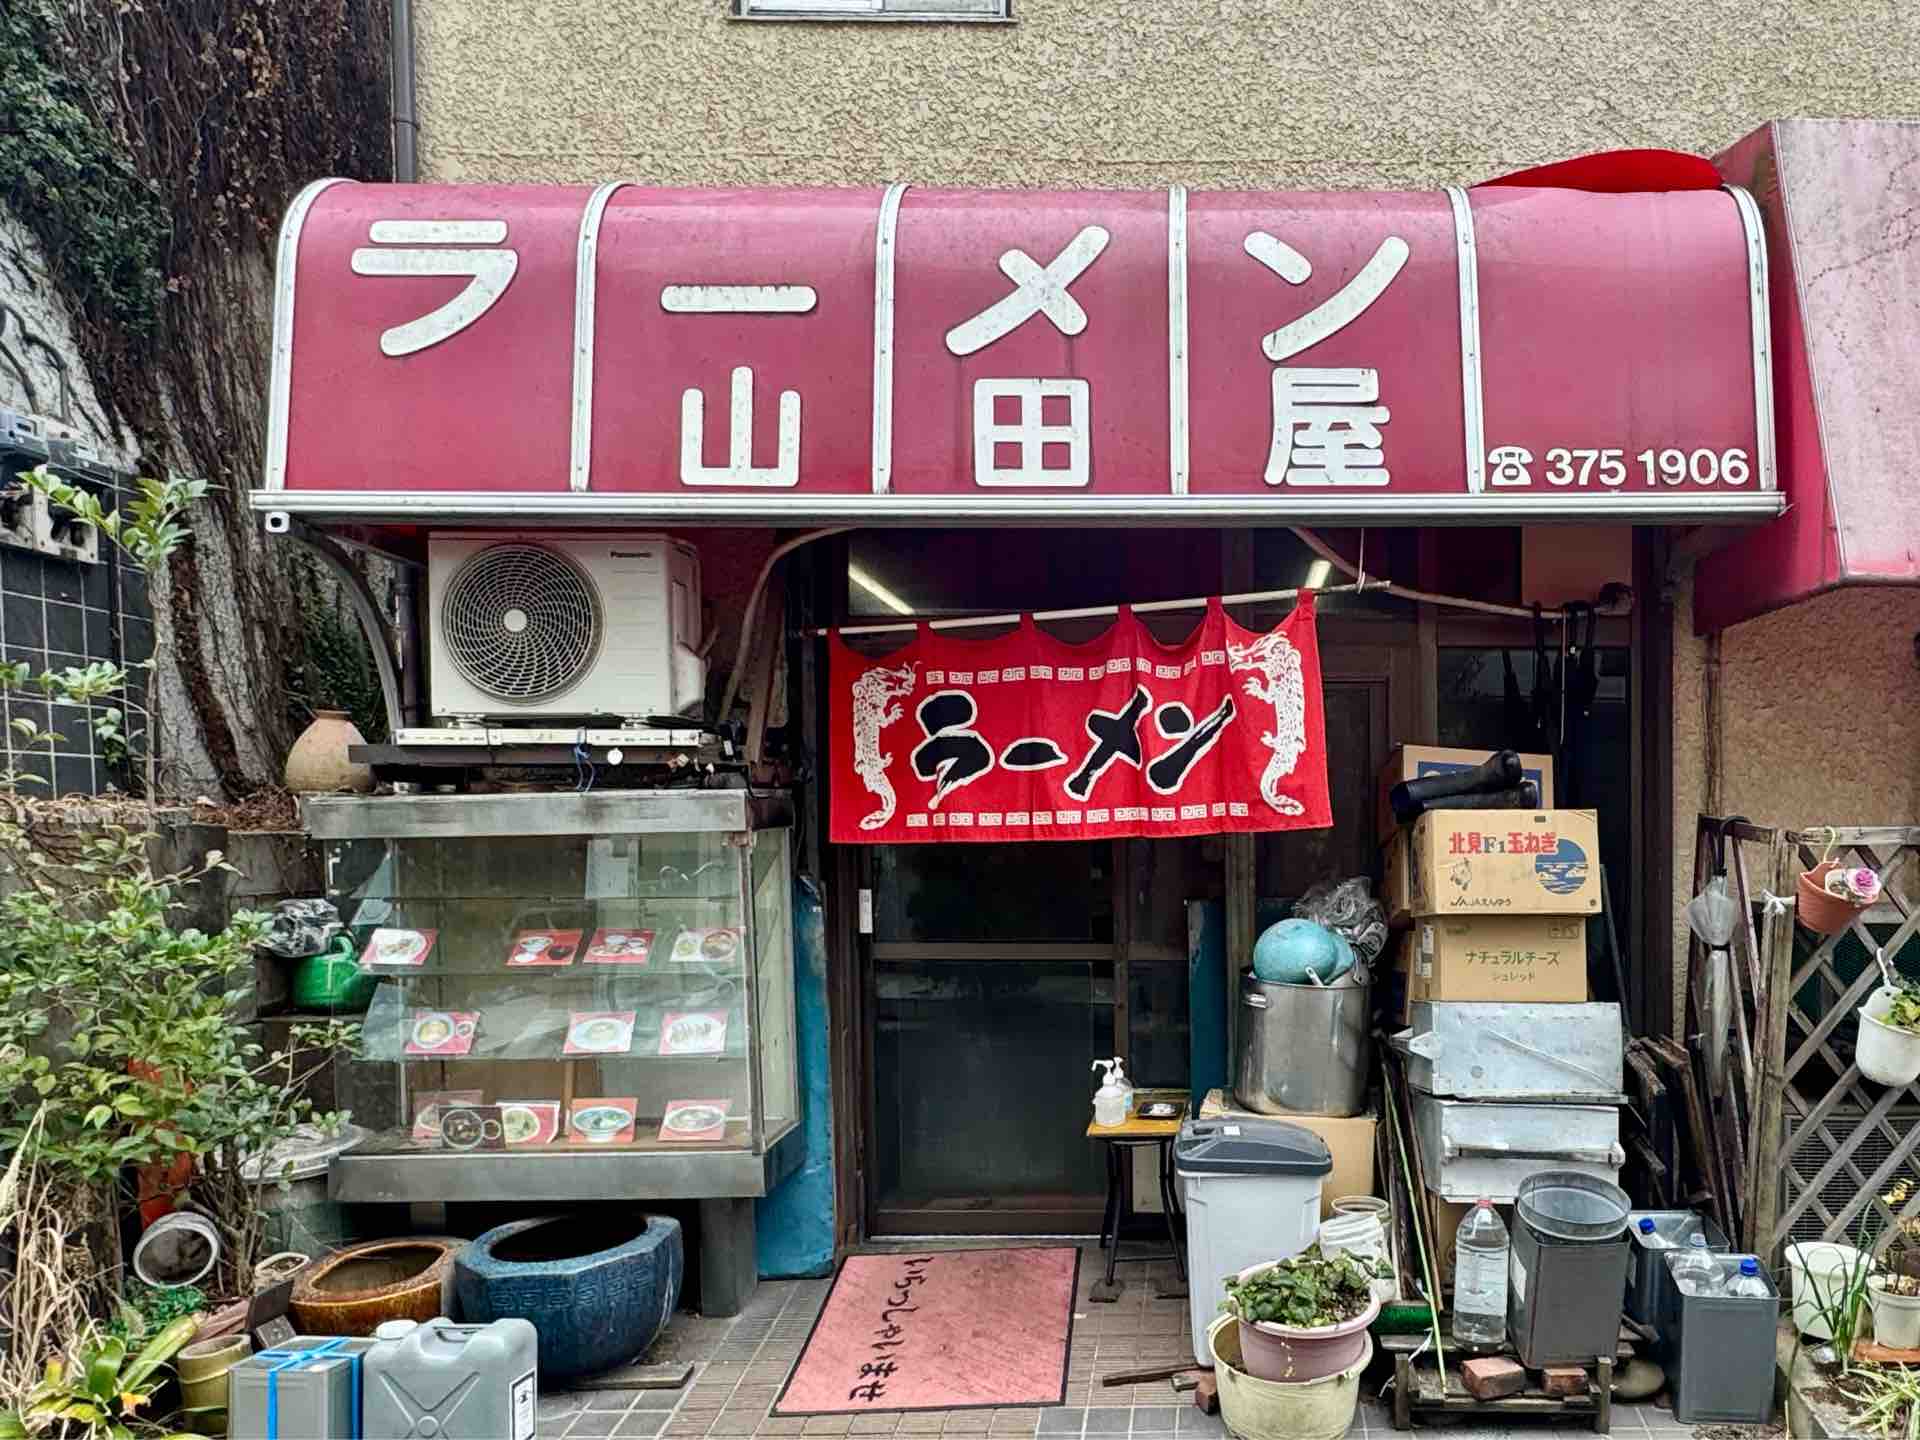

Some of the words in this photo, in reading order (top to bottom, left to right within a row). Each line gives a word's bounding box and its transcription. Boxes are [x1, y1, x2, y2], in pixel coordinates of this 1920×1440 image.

[351, 219, 1410, 361] ラーメン
[680, 365, 1391, 487] 山田屋
[1546, 448, 1626, 486] 375
[1637, 448, 1750, 486] 1906
[910, 684, 1234, 810] ラーメン
[1448, 831, 1557, 855] 北見F1玉ねぎ
[1464, 951, 1561, 967] ナチュラルチーズ
[848, 1256, 935, 1402] いらっしゃいませ
